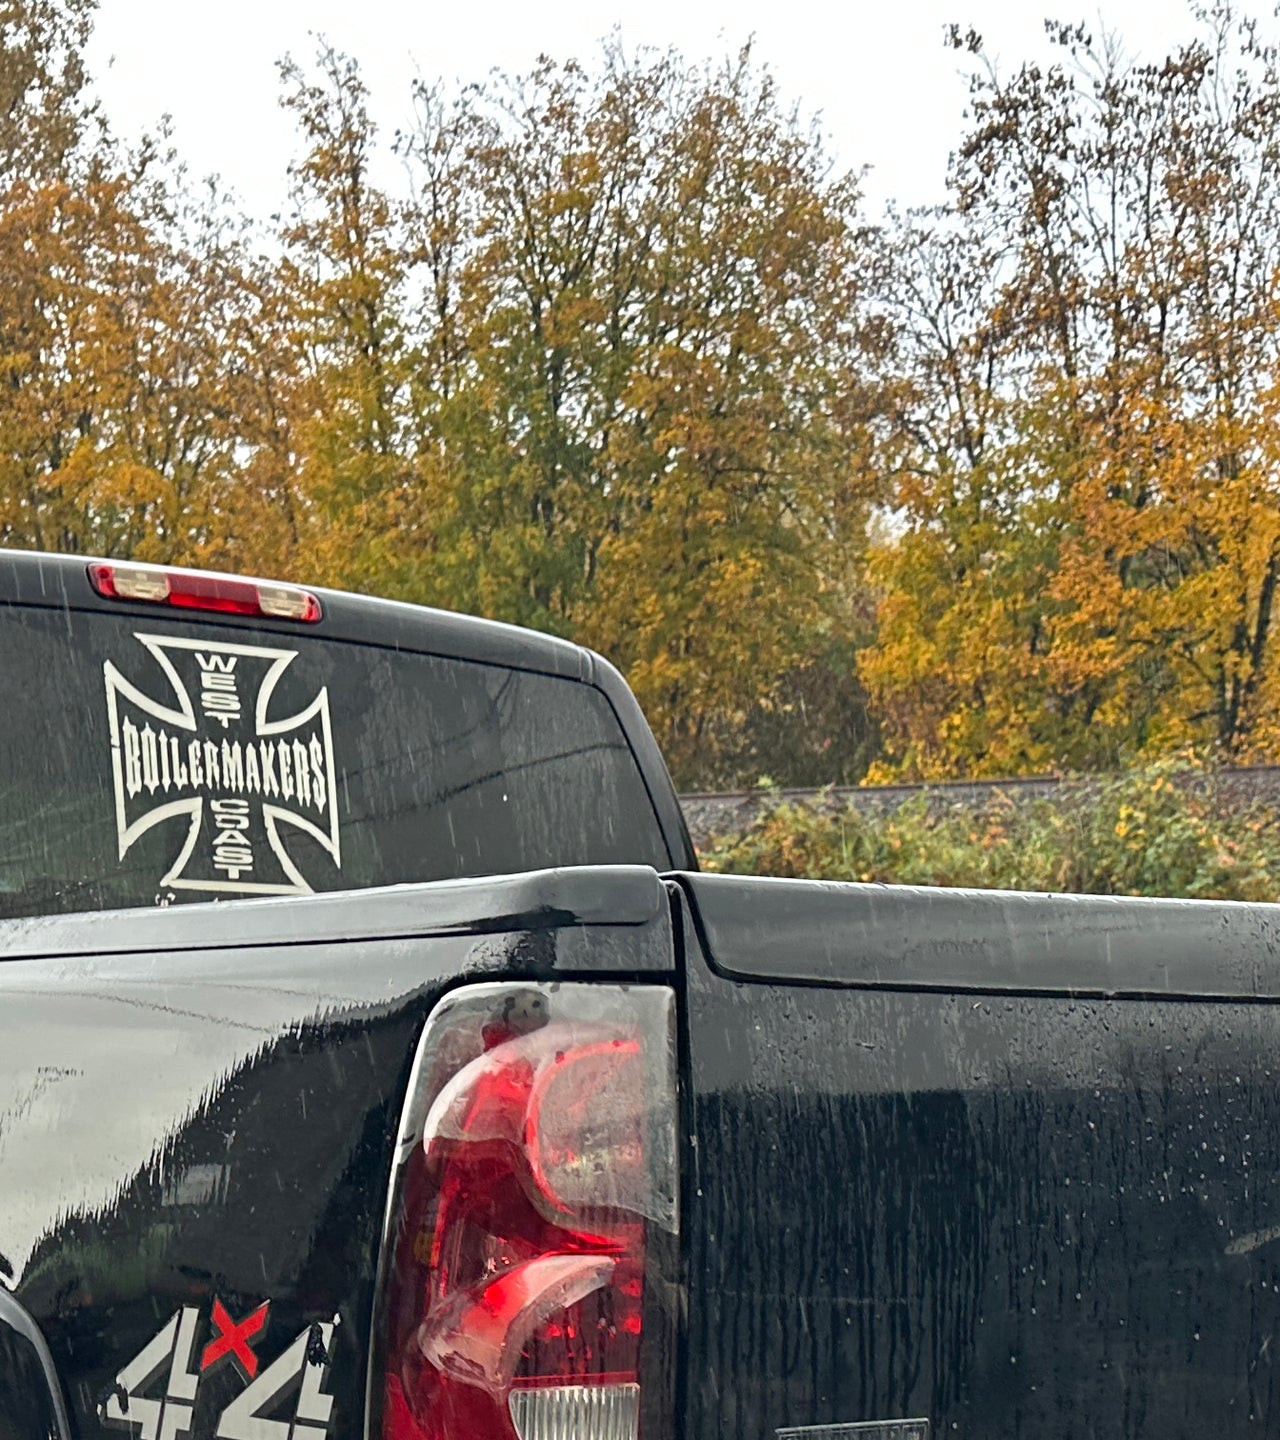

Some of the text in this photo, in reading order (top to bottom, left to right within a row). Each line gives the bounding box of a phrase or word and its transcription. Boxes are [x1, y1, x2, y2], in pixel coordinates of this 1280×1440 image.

[194, 652, 241, 728] WEST
[122, 715, 327, 815] BOILERMAKERS
[210, 799, 254, 879] COAST
